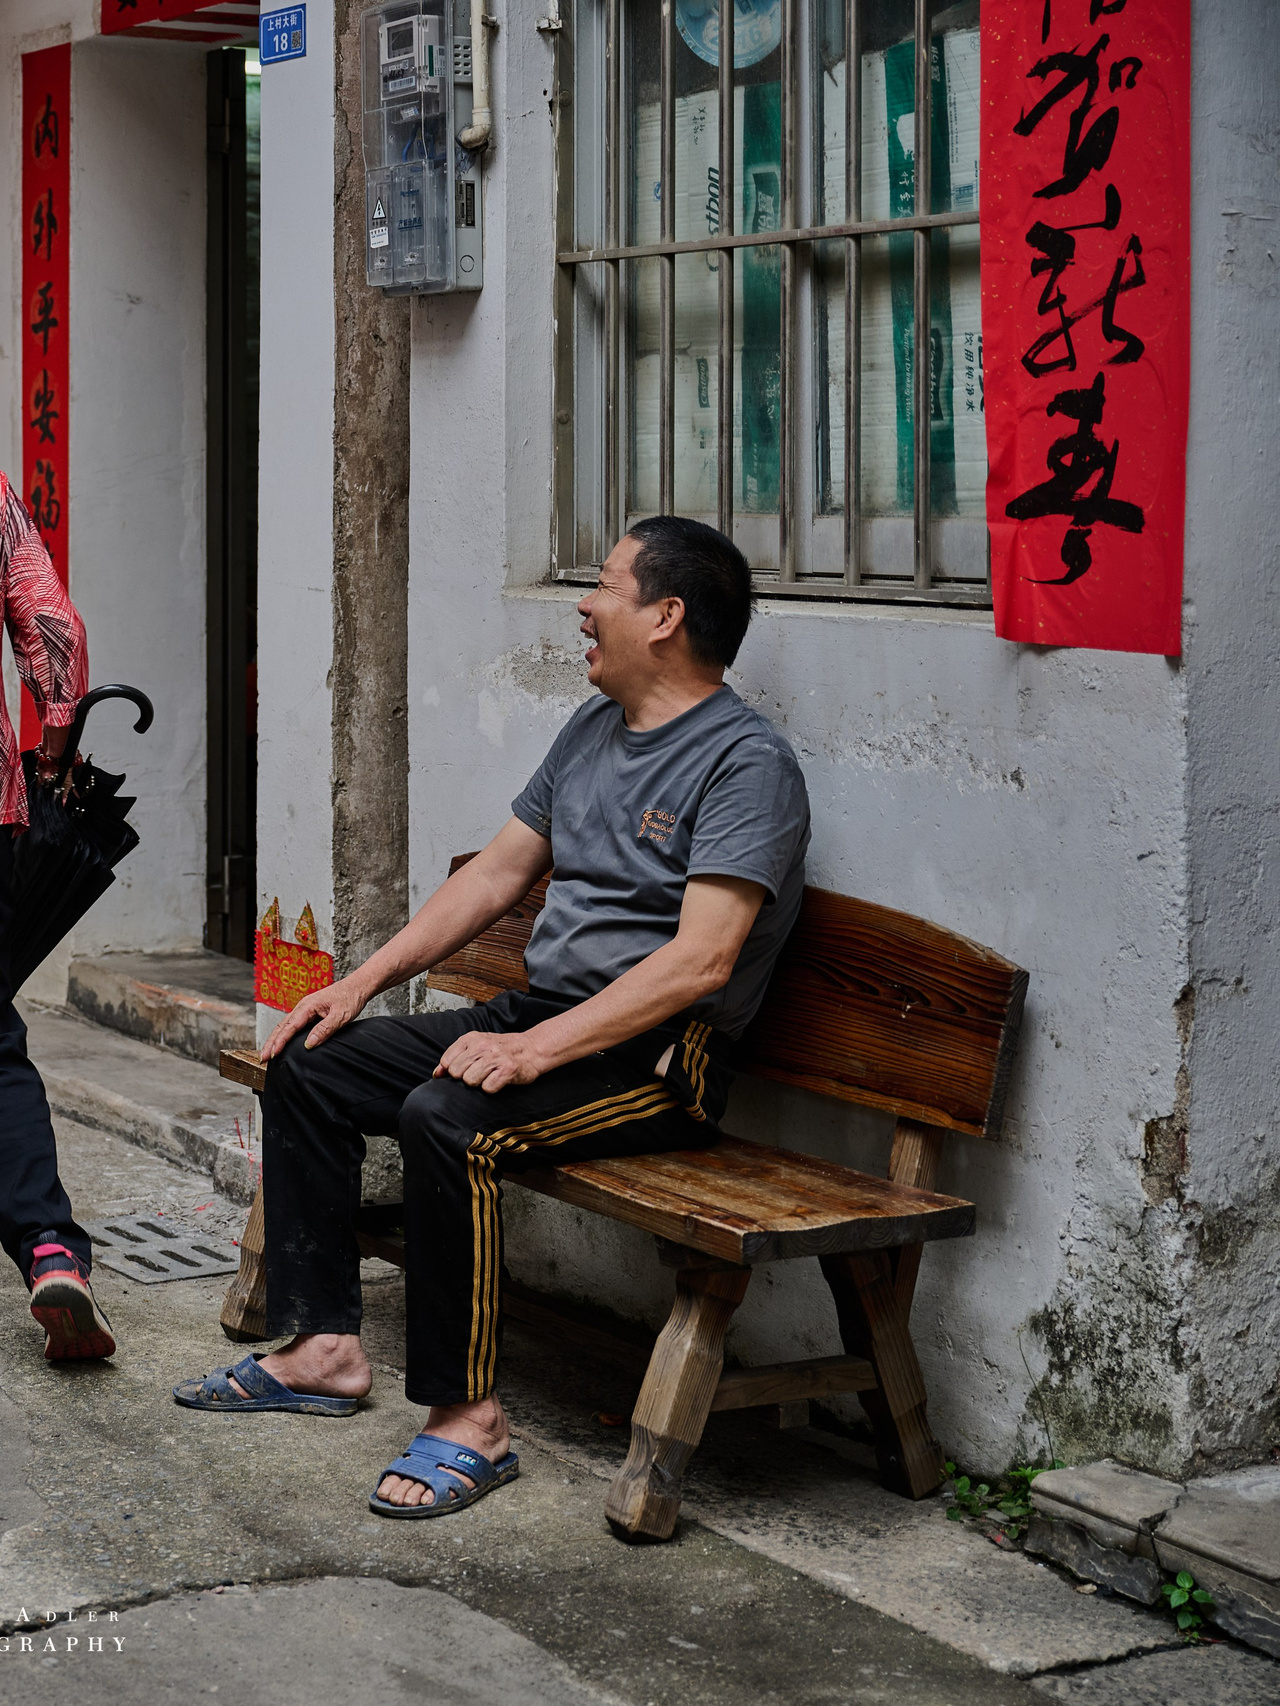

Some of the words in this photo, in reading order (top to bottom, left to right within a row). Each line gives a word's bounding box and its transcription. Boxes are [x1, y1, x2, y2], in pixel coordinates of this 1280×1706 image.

[267, 13, 297, 31] 上村大街
[273, 32, 288, 52] 18
[31, 93, 60, 558] 内外平安福
[964, 332, 975, 411] 饮用纯净水
